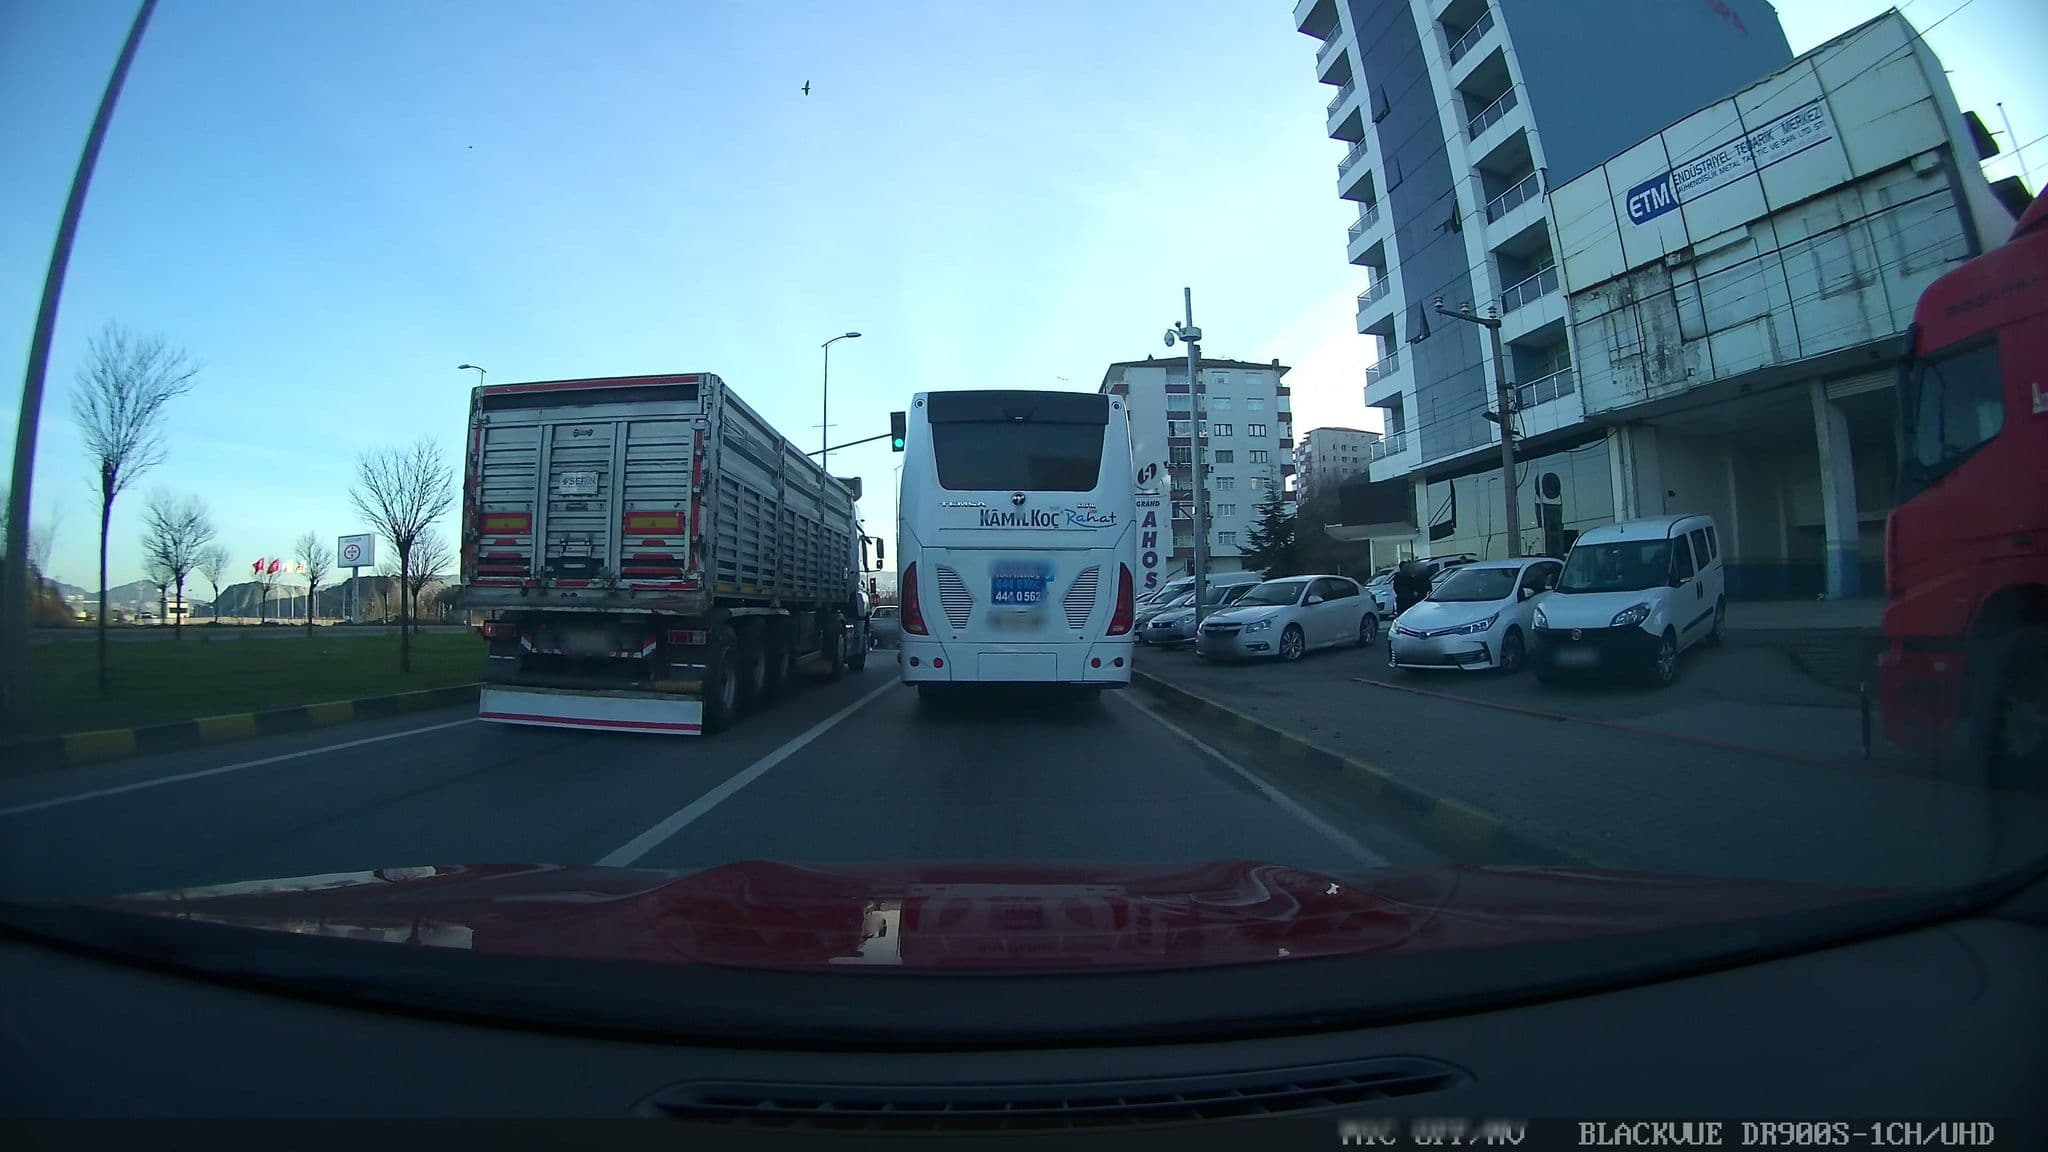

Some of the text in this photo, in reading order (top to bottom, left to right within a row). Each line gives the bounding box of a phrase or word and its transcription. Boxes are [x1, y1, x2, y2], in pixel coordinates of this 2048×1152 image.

[1630, 182, 1670, 218] ETM
[1136, 500, 1160, 508] GRAND
[1064, 508, 1117, 529] Rahat
[1142, 510, 1158, 589] AHOS
